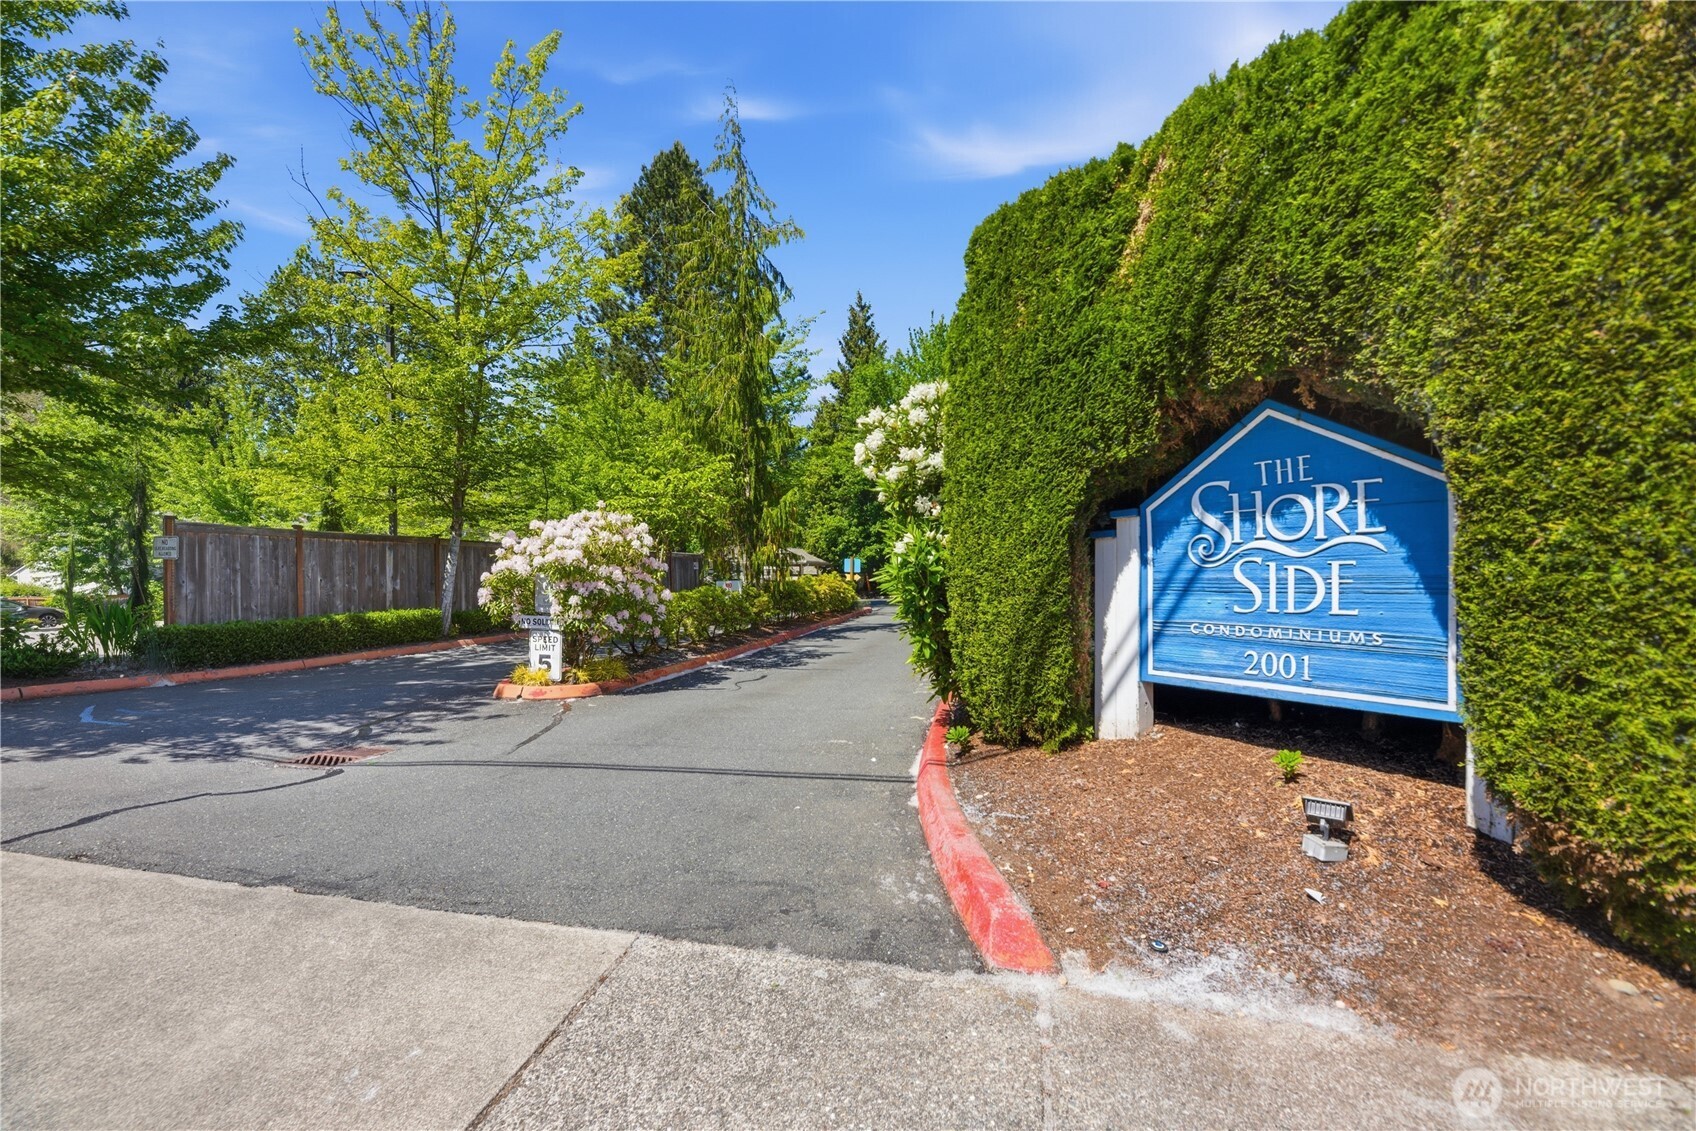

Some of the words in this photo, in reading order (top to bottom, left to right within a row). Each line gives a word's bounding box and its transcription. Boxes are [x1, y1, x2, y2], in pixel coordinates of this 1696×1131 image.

[1253, 454, 1314, 487] THE
[1188, 477, 1387, 567] SHORE
[1233, 557, 1359, 616] SIDE
[532, 635, 559, 644] SPEED
[534, 644, 556, 652] LIMIT
[1190, 623, 1384, 646] CONDOMINIUMS
[538, 654, 552, 673] 5
[1243, 650, 1313, 682] 2001
